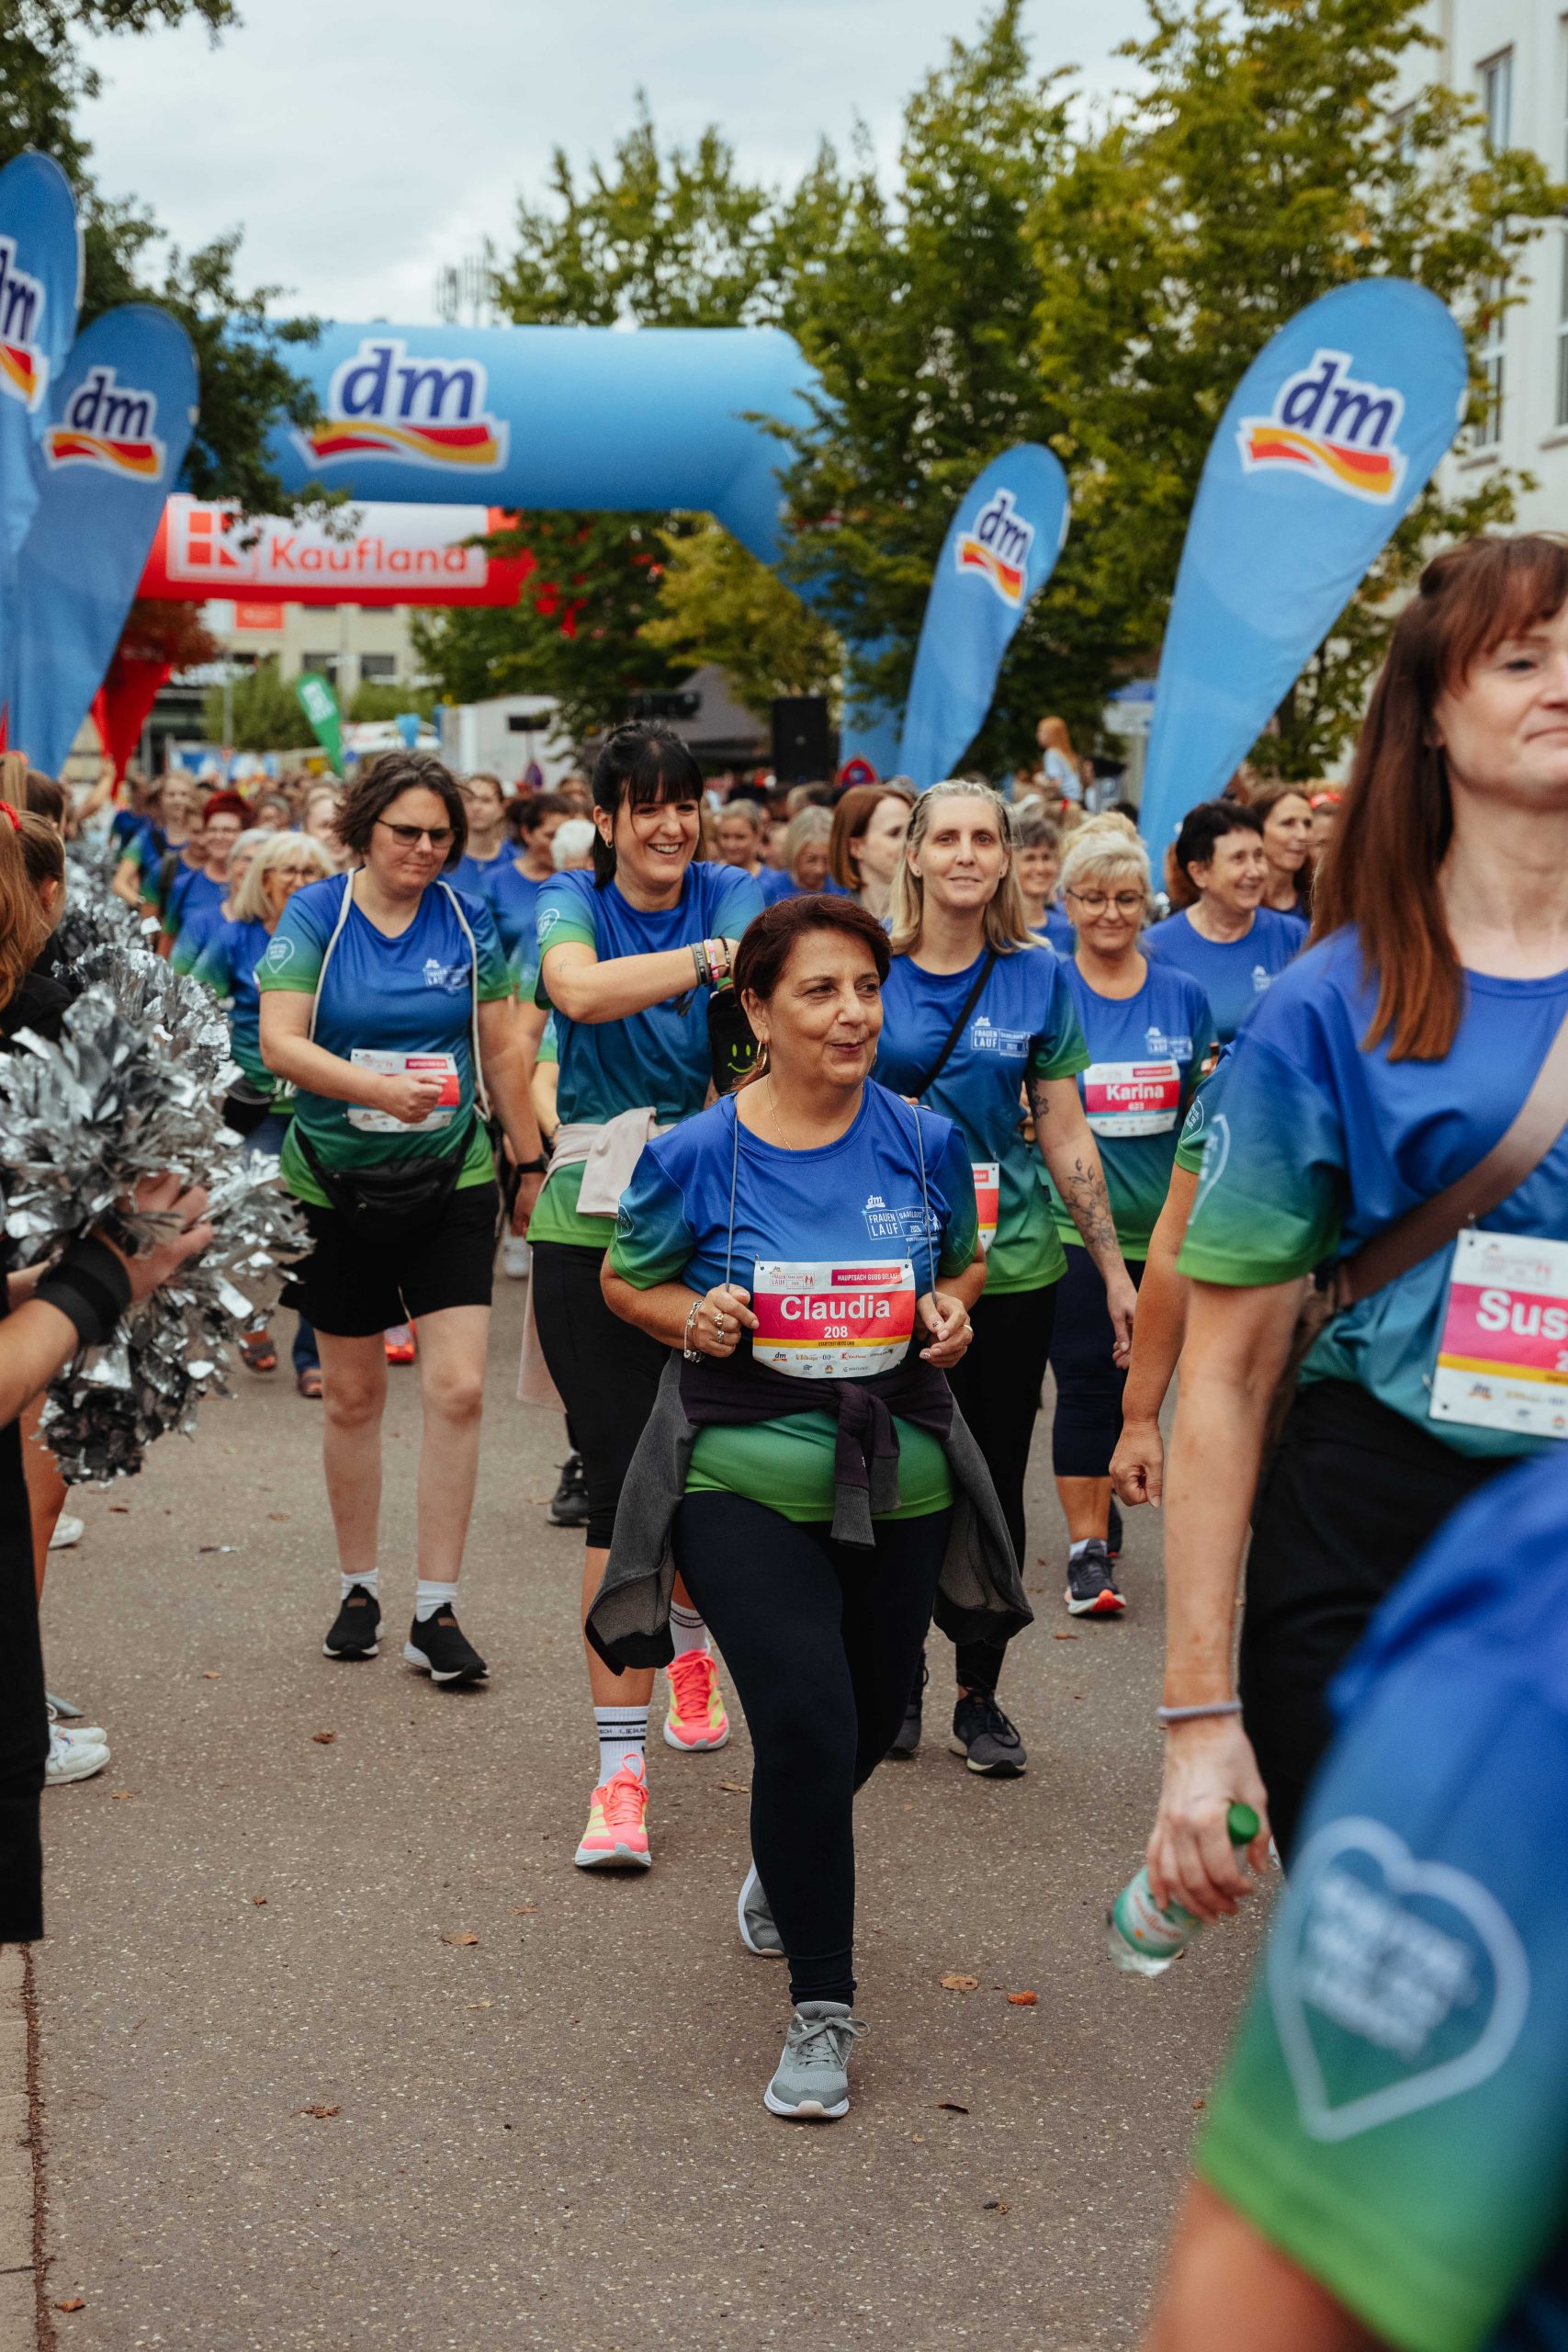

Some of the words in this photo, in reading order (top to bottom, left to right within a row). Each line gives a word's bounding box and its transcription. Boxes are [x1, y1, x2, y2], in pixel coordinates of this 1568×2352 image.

[0, 246, 36, 343] m
[341, 347, 475, 418] dm
[71, 373, 150, 438] dm
[1280, 360, 1394, 449] dm
[977, 499, 1030, 565] dm
[271, 537, 467, 573] Kaufland
[974, 1037, 998, 1048] LAUF
[1106, 1084, 1165, 1101] Karina
[867, 1195, 883, 1204] dm
[868, 1213, 897, 1224] FRAUEN
[871, 1223, 899, 1237] LAUF
[781, 1295, 891, 1320] Claudia
[823, 1326, 849, 1339] 208
